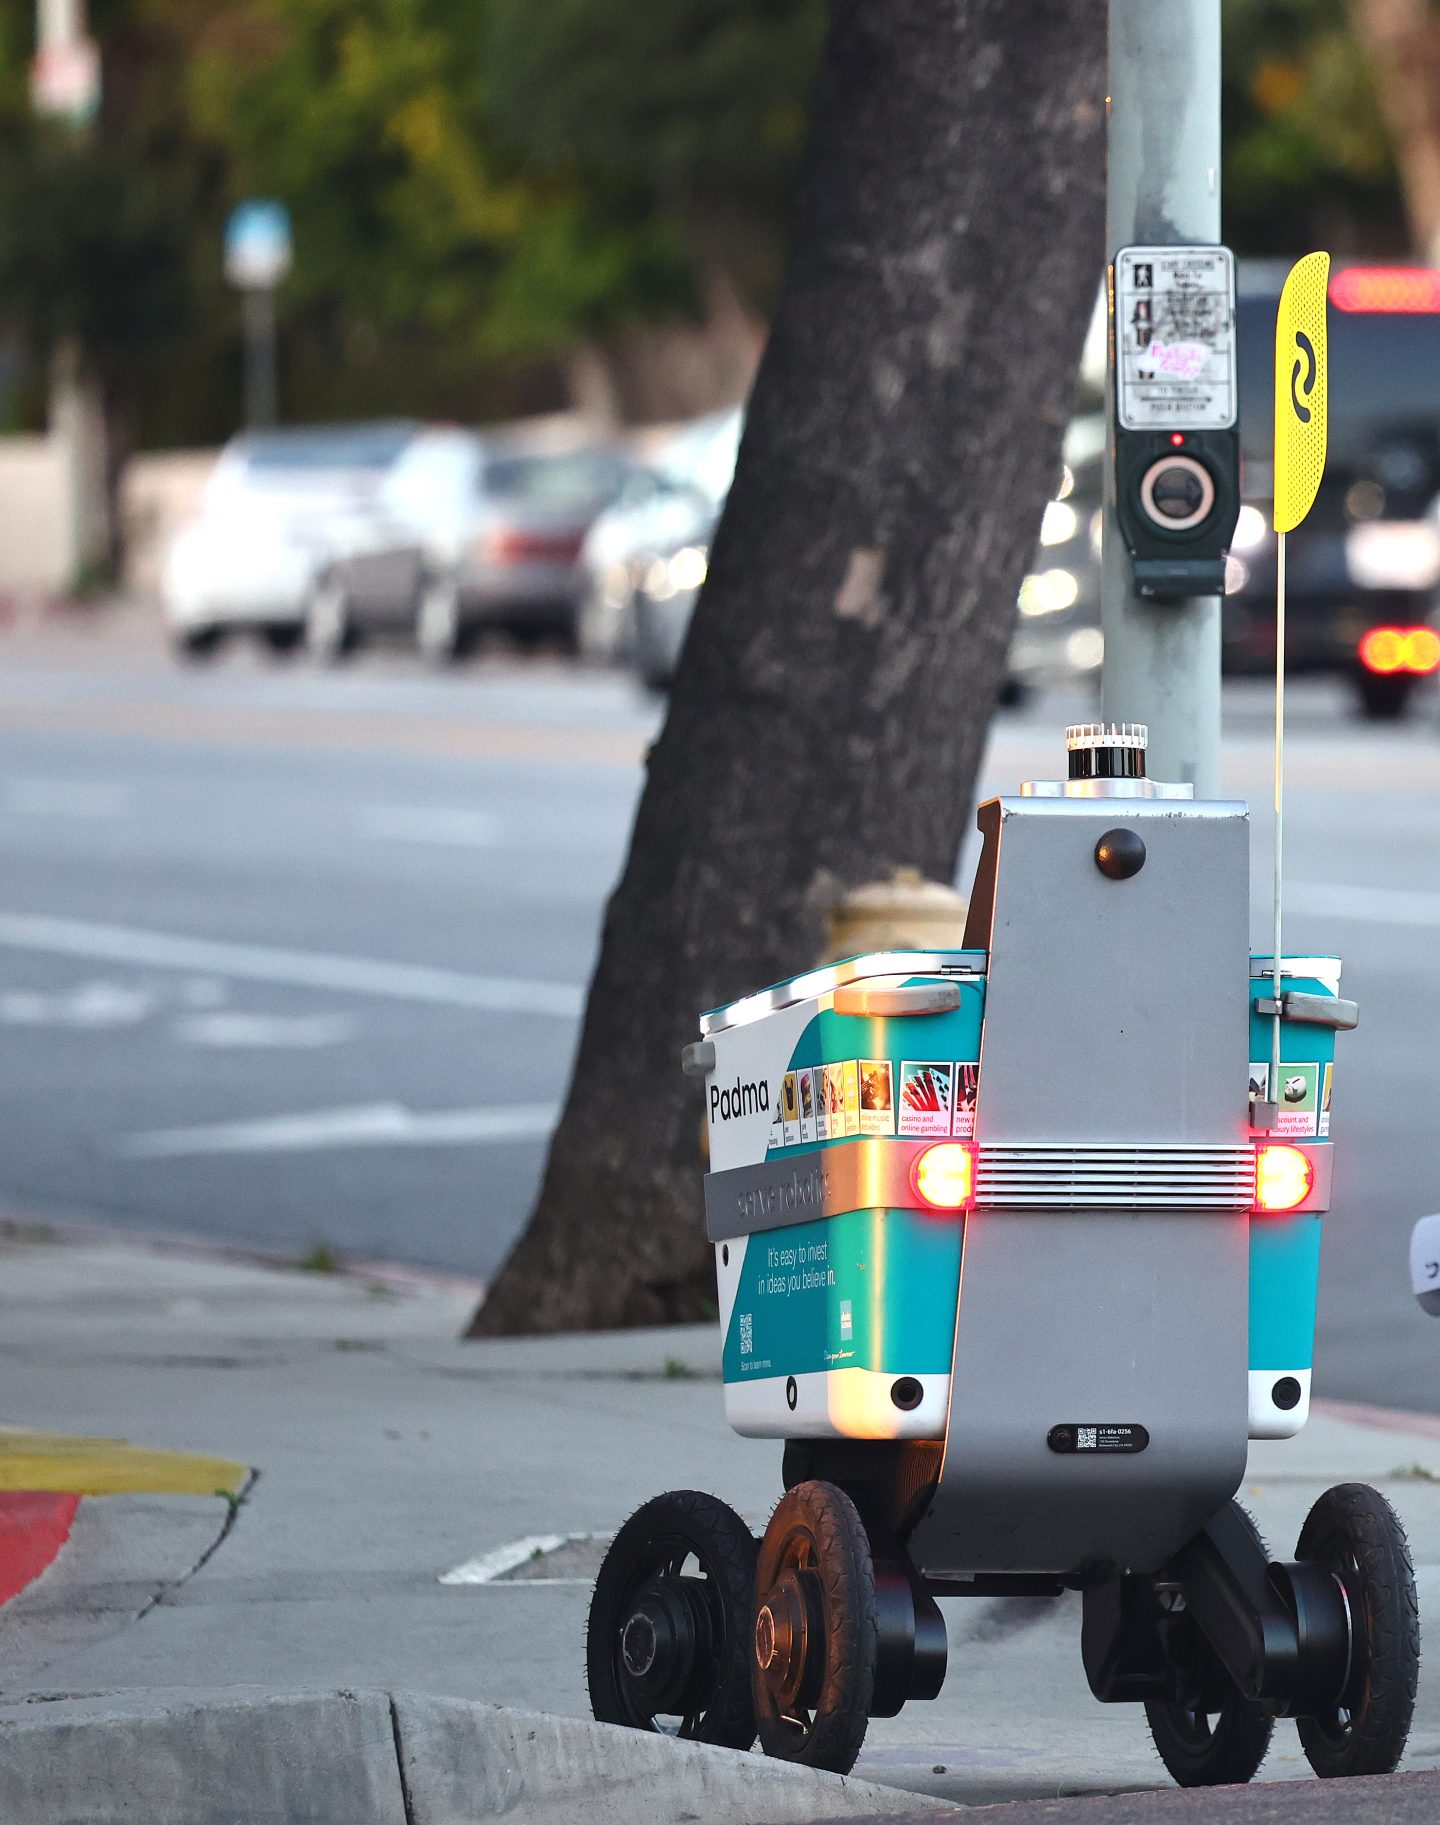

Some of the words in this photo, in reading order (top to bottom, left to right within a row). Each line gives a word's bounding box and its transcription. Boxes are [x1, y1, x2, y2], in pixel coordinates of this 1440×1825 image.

[710, 1076, 769, 1124] Padma
[901, 1114, 920, 1122] casino
[922, 1114, 934, 1122] and
[901, 1121, 919, 1132] online
[921, 1121, 948, 1134] gambling
[738, 1187, 776, 1217] serve
[778, 1166, 832, 1212] robotics
[767, 1247, 779, 1268] It's
[780, 1249, 797, 1270] easy
[798, 1244, 807, 1264] to
[807, 1240, 828, 1262] invest
[758, 1274, 766, 1296] in
[766, 1273, 786, 1294] ideas
[787, 1274, 801, 1297] you
[802, 1267, 827, 1290] believe
[827, 1264, 836, 1287] in.
